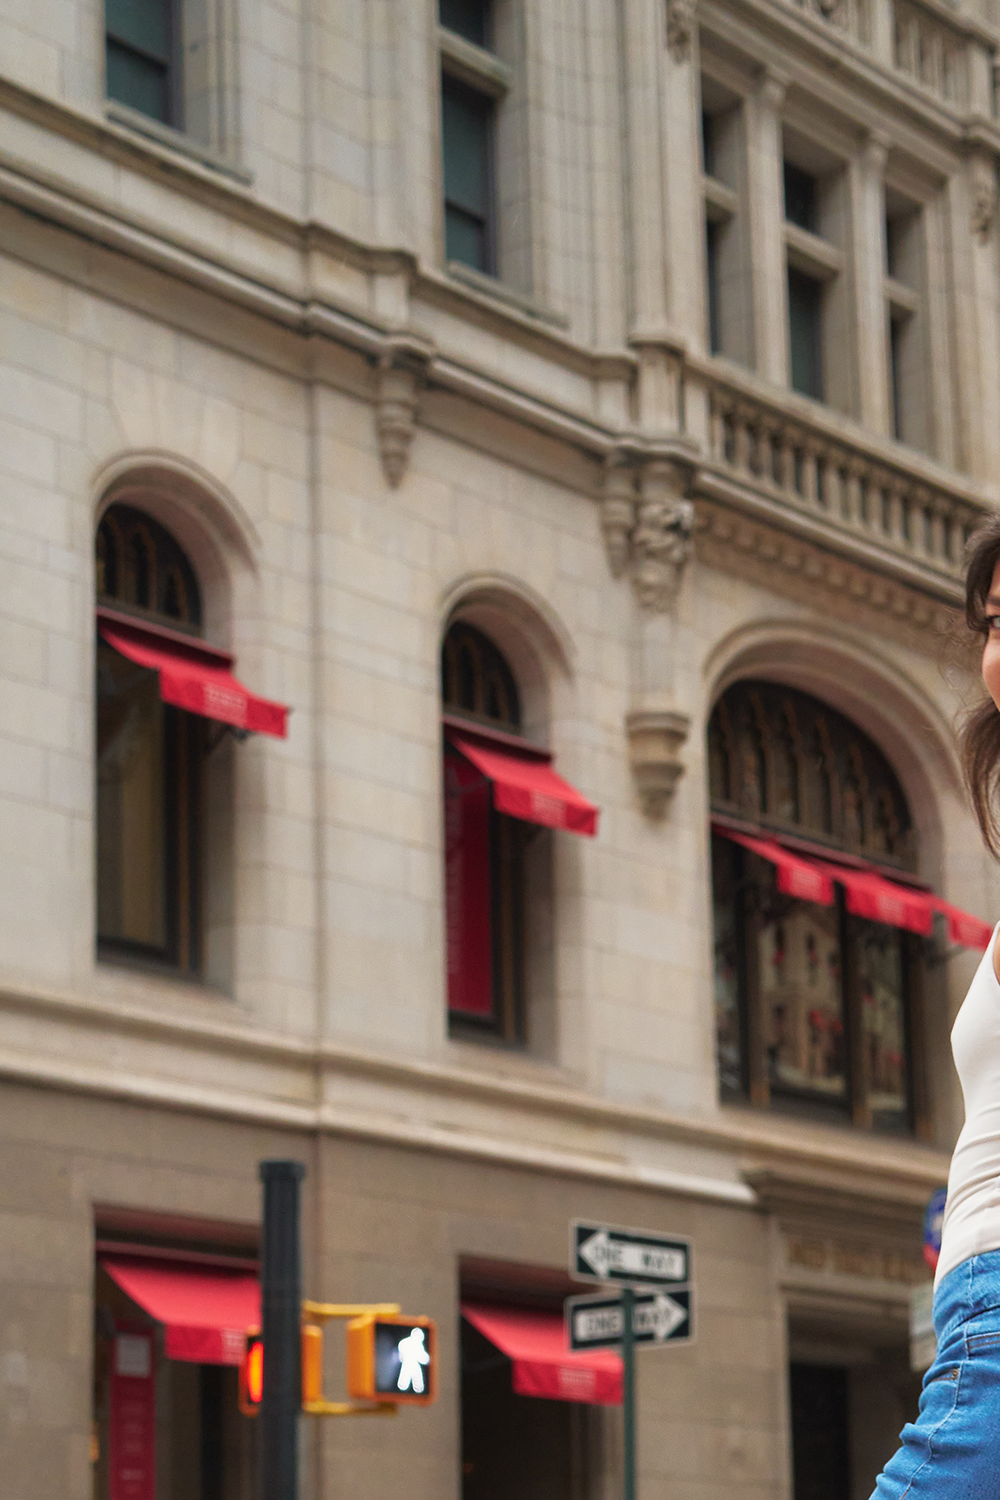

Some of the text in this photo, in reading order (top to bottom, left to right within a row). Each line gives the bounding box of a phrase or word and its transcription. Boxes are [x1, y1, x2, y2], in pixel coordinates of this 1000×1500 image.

[593, 1244, 676, 1273] ONE WAY
[586, 1306, 673, 1333] ONE WAY
